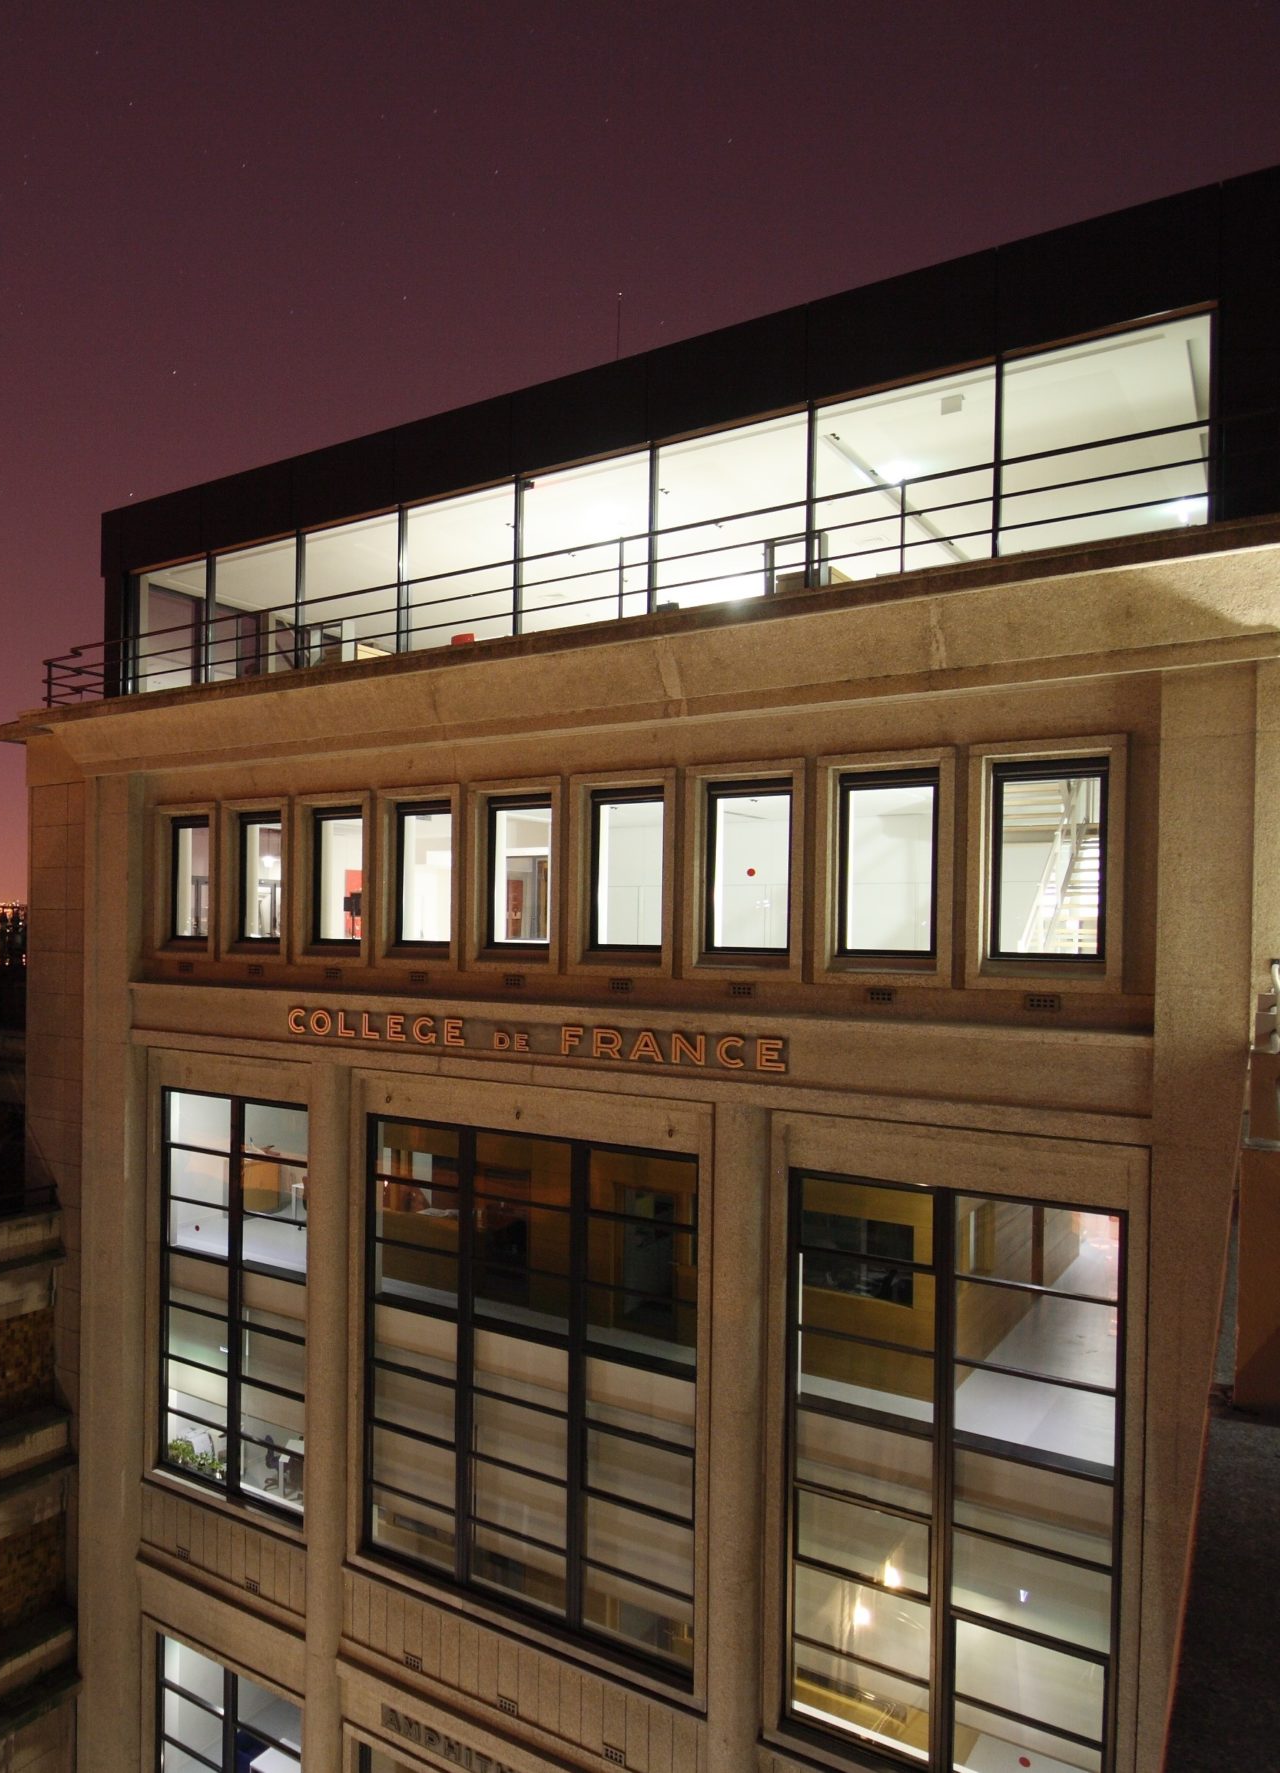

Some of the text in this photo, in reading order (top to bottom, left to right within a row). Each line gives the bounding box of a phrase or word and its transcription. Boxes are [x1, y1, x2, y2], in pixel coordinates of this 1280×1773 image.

[288, 1008, 786, 1072] COLLEGE DE FRANCE
